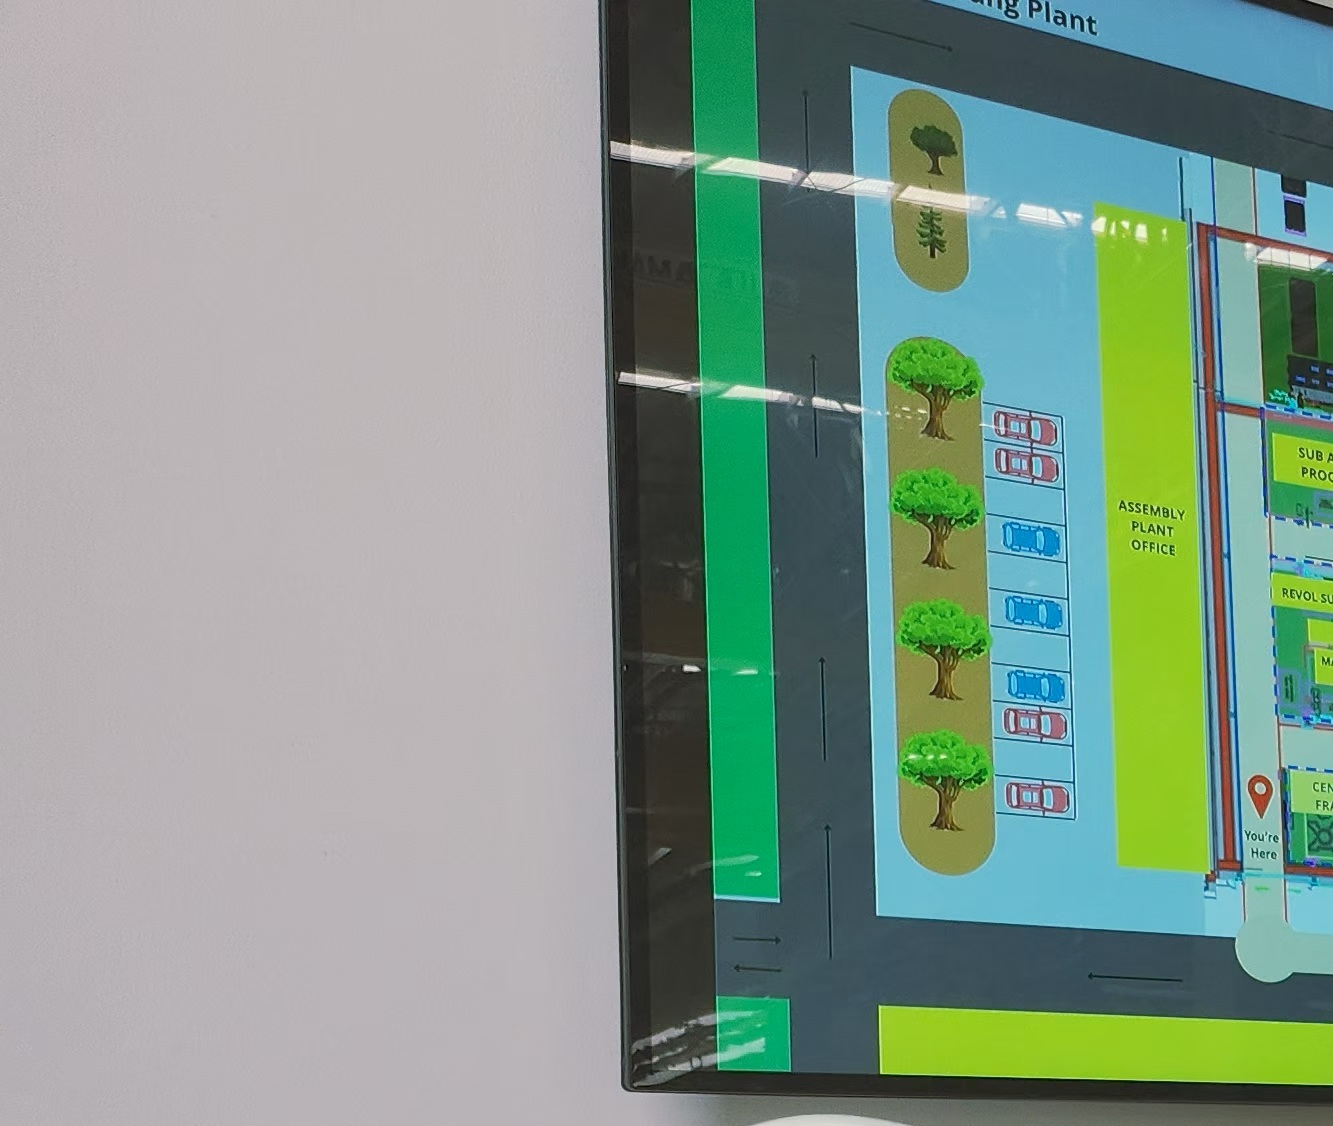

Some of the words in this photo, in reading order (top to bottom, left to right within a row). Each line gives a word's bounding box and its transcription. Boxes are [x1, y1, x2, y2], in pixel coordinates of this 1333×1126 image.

[1028, 0, 1098, 35] Plant
[1298, 447, 1324, 462] SUB
[1119, 499, 1185, 520] ASSEMBLY
[1131, 520, 1174, 537] PLANT
[1131, 539, 1176, 556] OFFICE
[1282, 587, 1318, 603] REVOL
[1244, 830, 1279, 844] You're
[1251, 848, 1277, 860] Here
